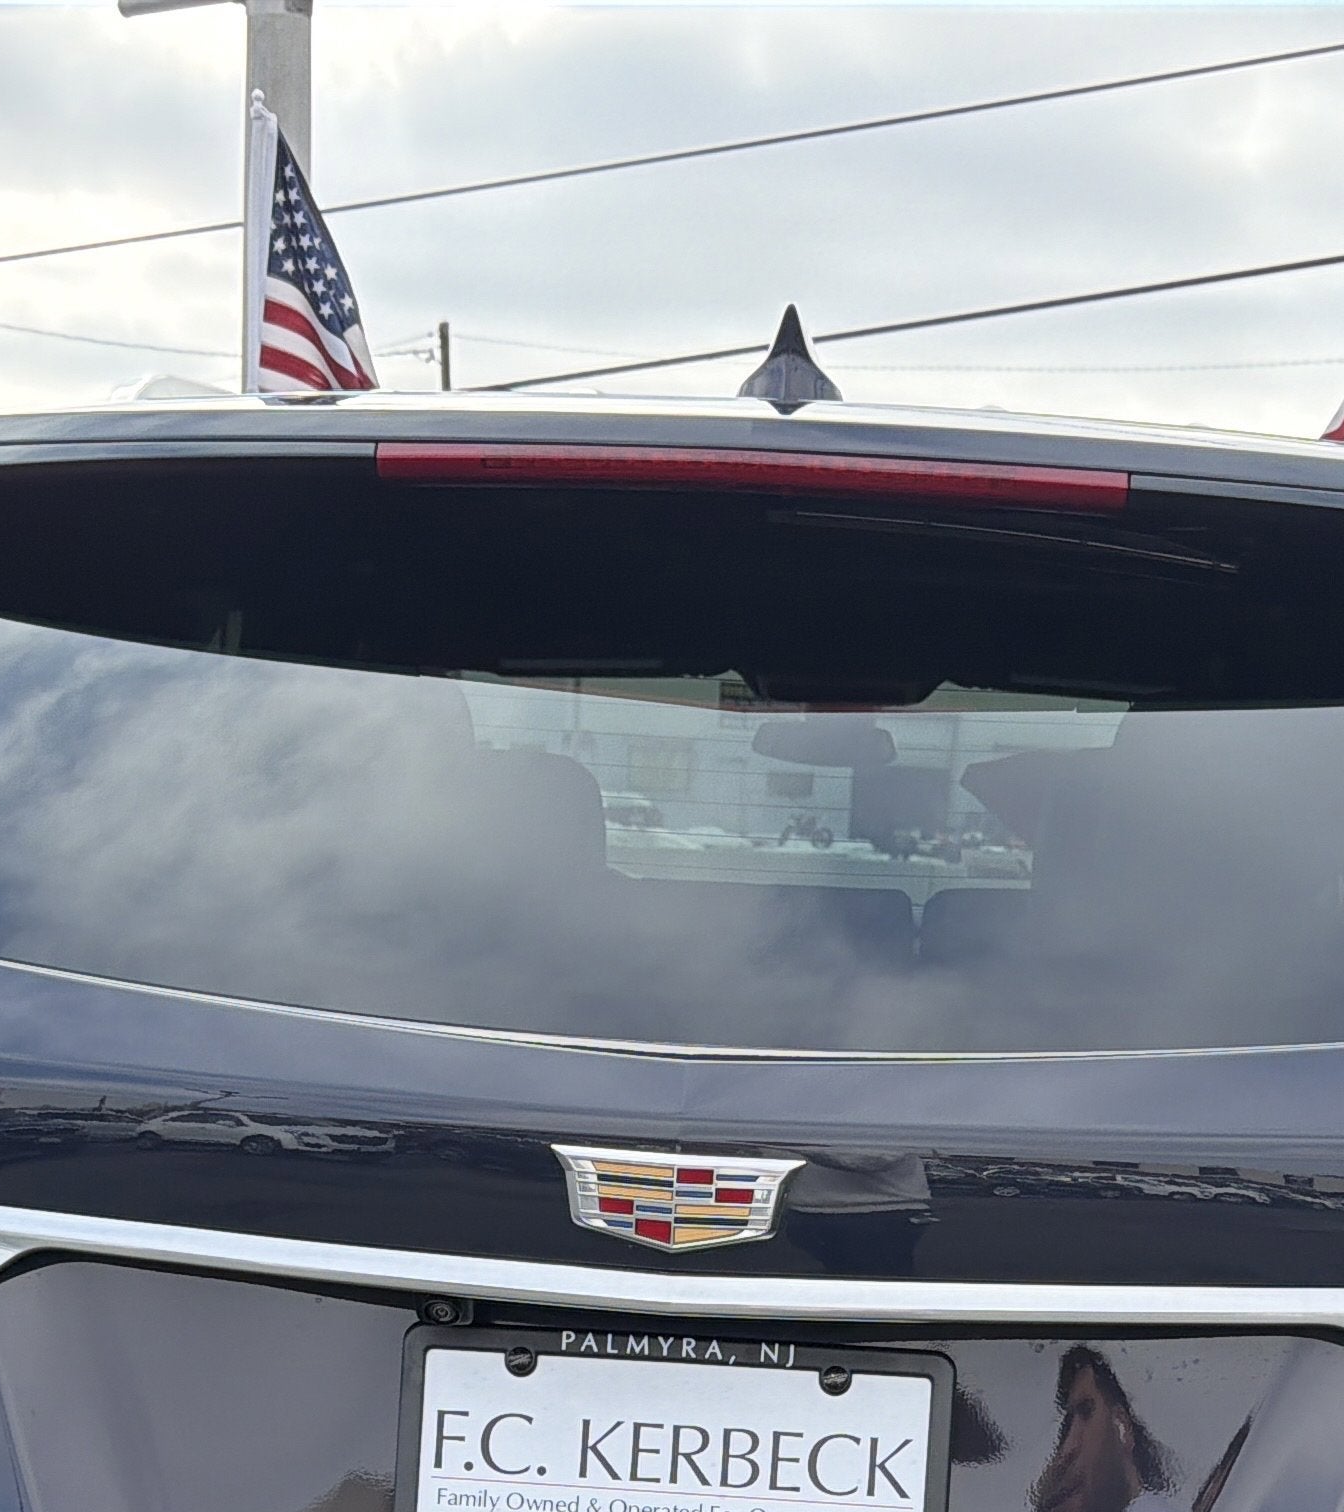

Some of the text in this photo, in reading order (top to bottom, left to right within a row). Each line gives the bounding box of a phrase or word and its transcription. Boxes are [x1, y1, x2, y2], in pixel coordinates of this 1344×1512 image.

[561, 1330, 796, 1368] PALMYRA, NJ
[433, 1409, 914, 1500] F.C. KERBECK
[436, 1487, 501, 1512] Family
